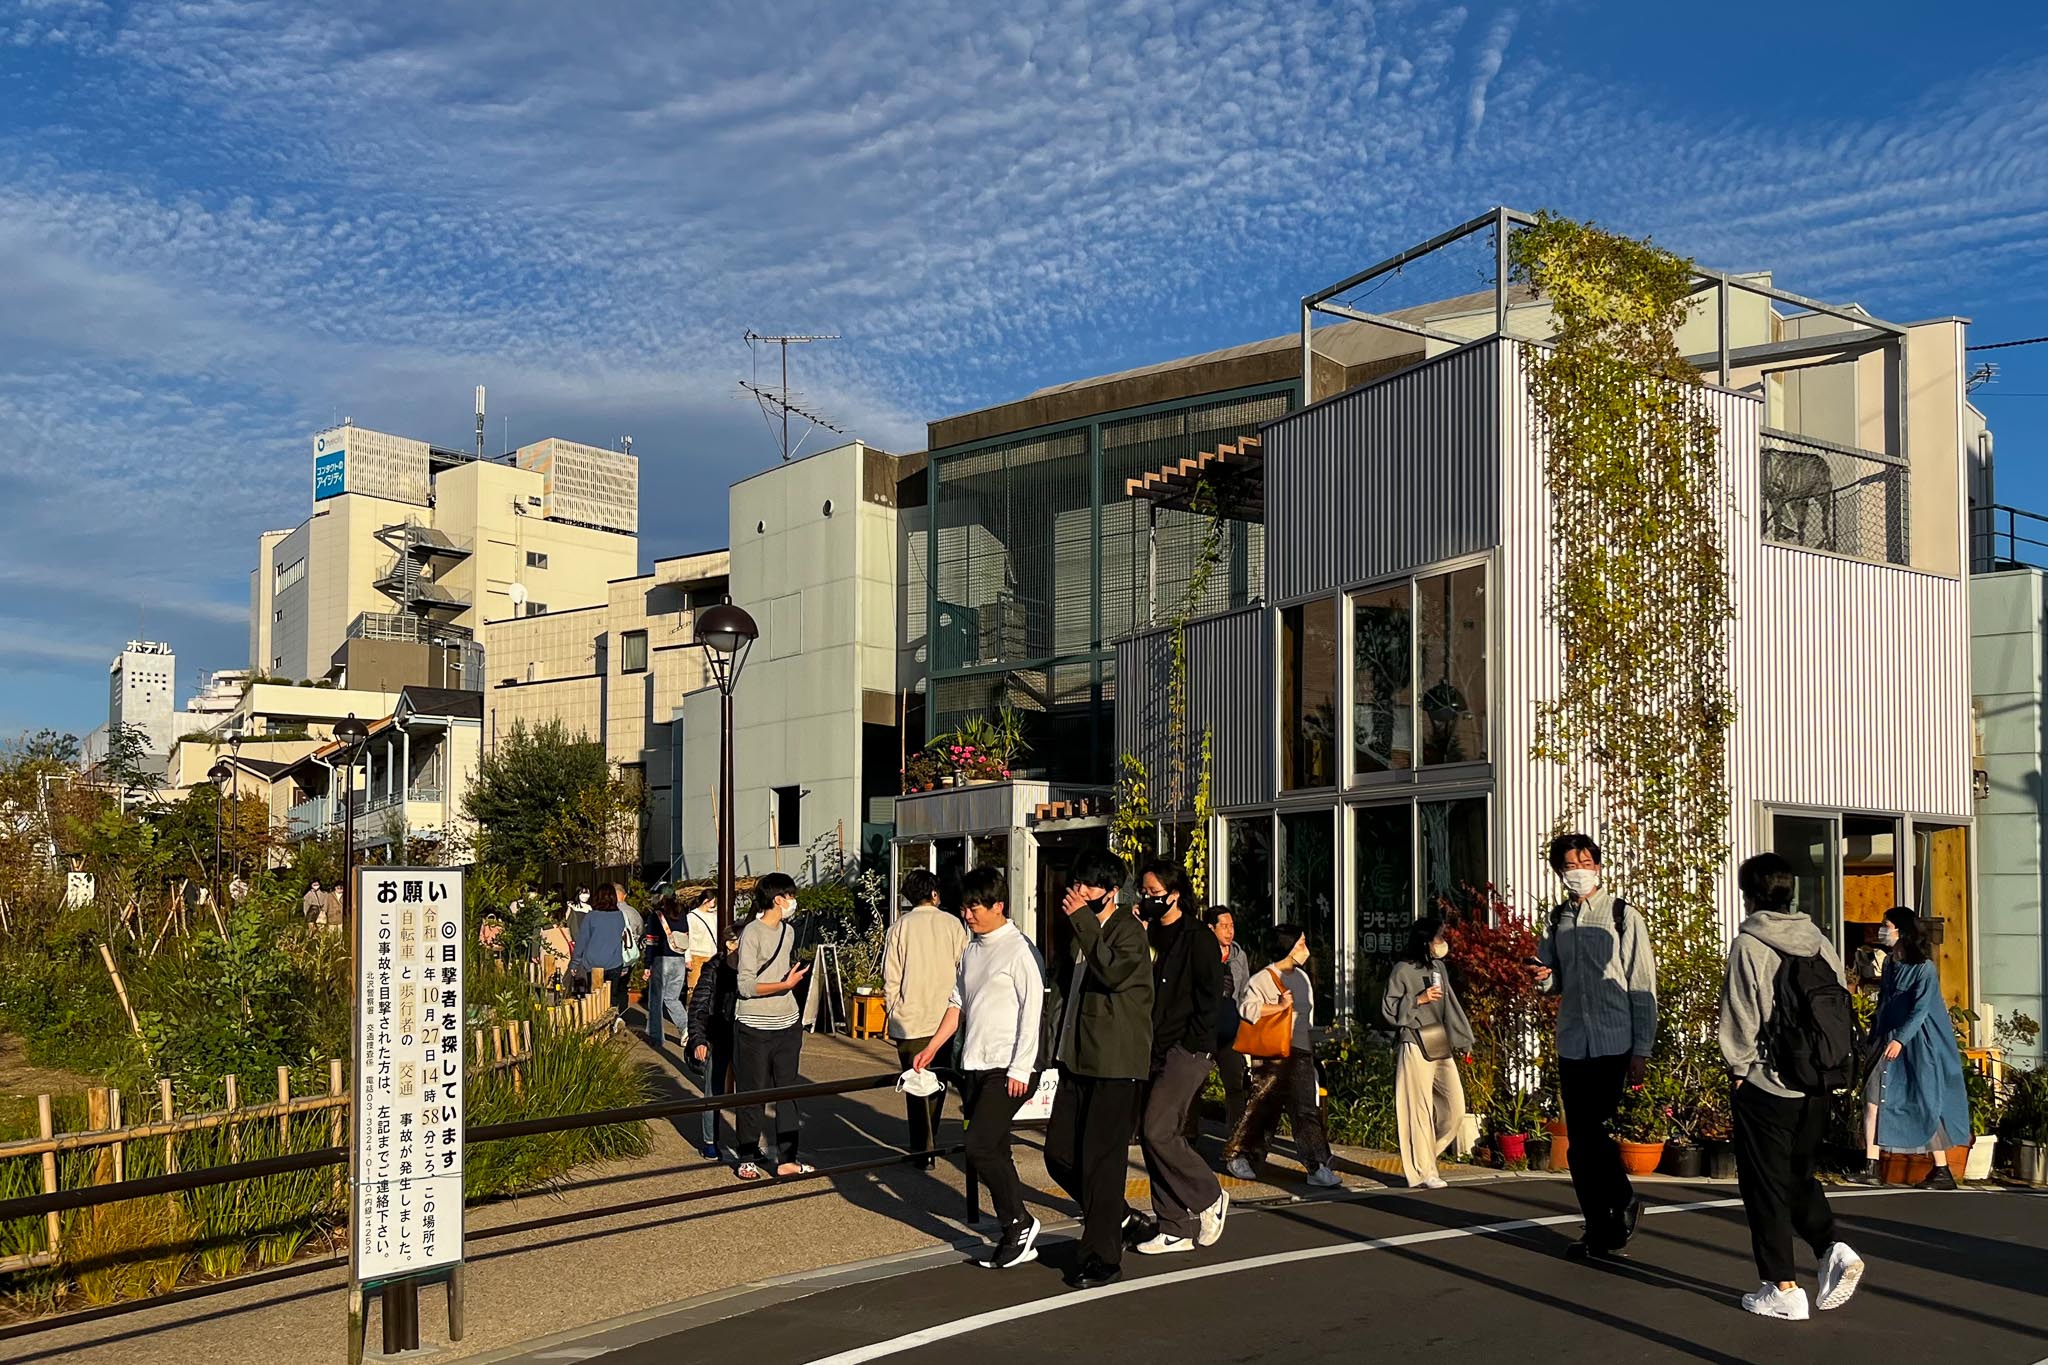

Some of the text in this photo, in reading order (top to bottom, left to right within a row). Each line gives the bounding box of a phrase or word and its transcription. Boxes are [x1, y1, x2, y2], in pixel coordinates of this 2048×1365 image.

[317, 472, 343, 488] アイシティ
[127, 640, 172, 655] ホテル
[377, 881, 447, 903] お願い
[1363, 911, 1410, 929] シモキタ
